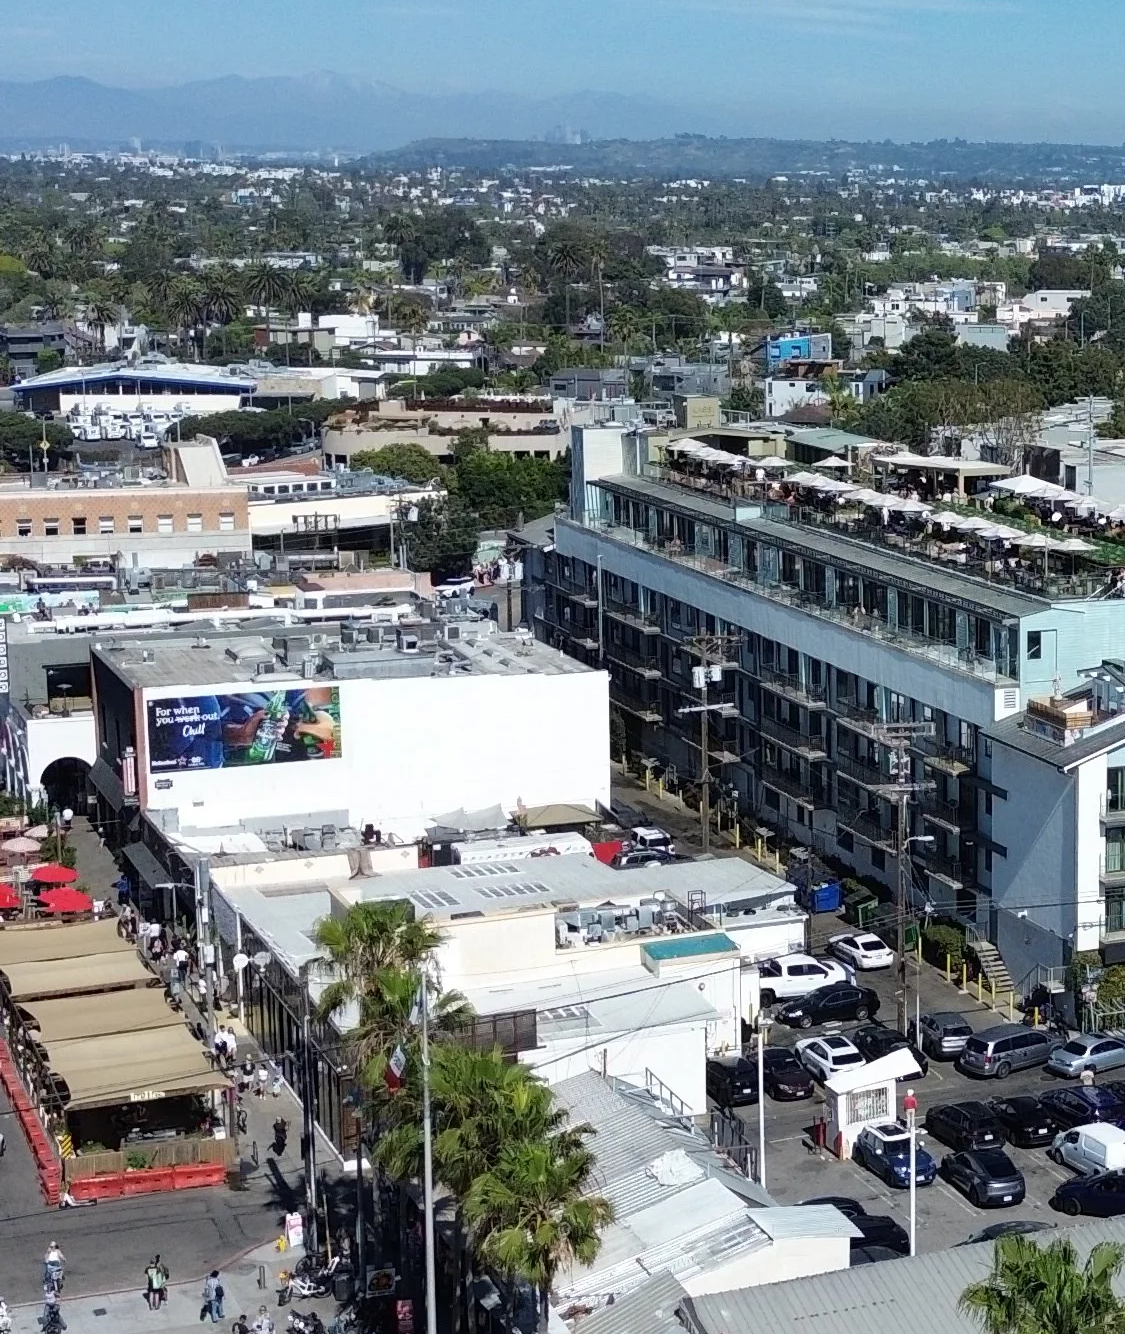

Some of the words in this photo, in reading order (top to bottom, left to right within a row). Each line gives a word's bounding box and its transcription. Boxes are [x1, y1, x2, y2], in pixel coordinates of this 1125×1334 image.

[156, 707, 172, 717] For
[173, 705, 200, 716] when
[156, 716, 174, 727] you
